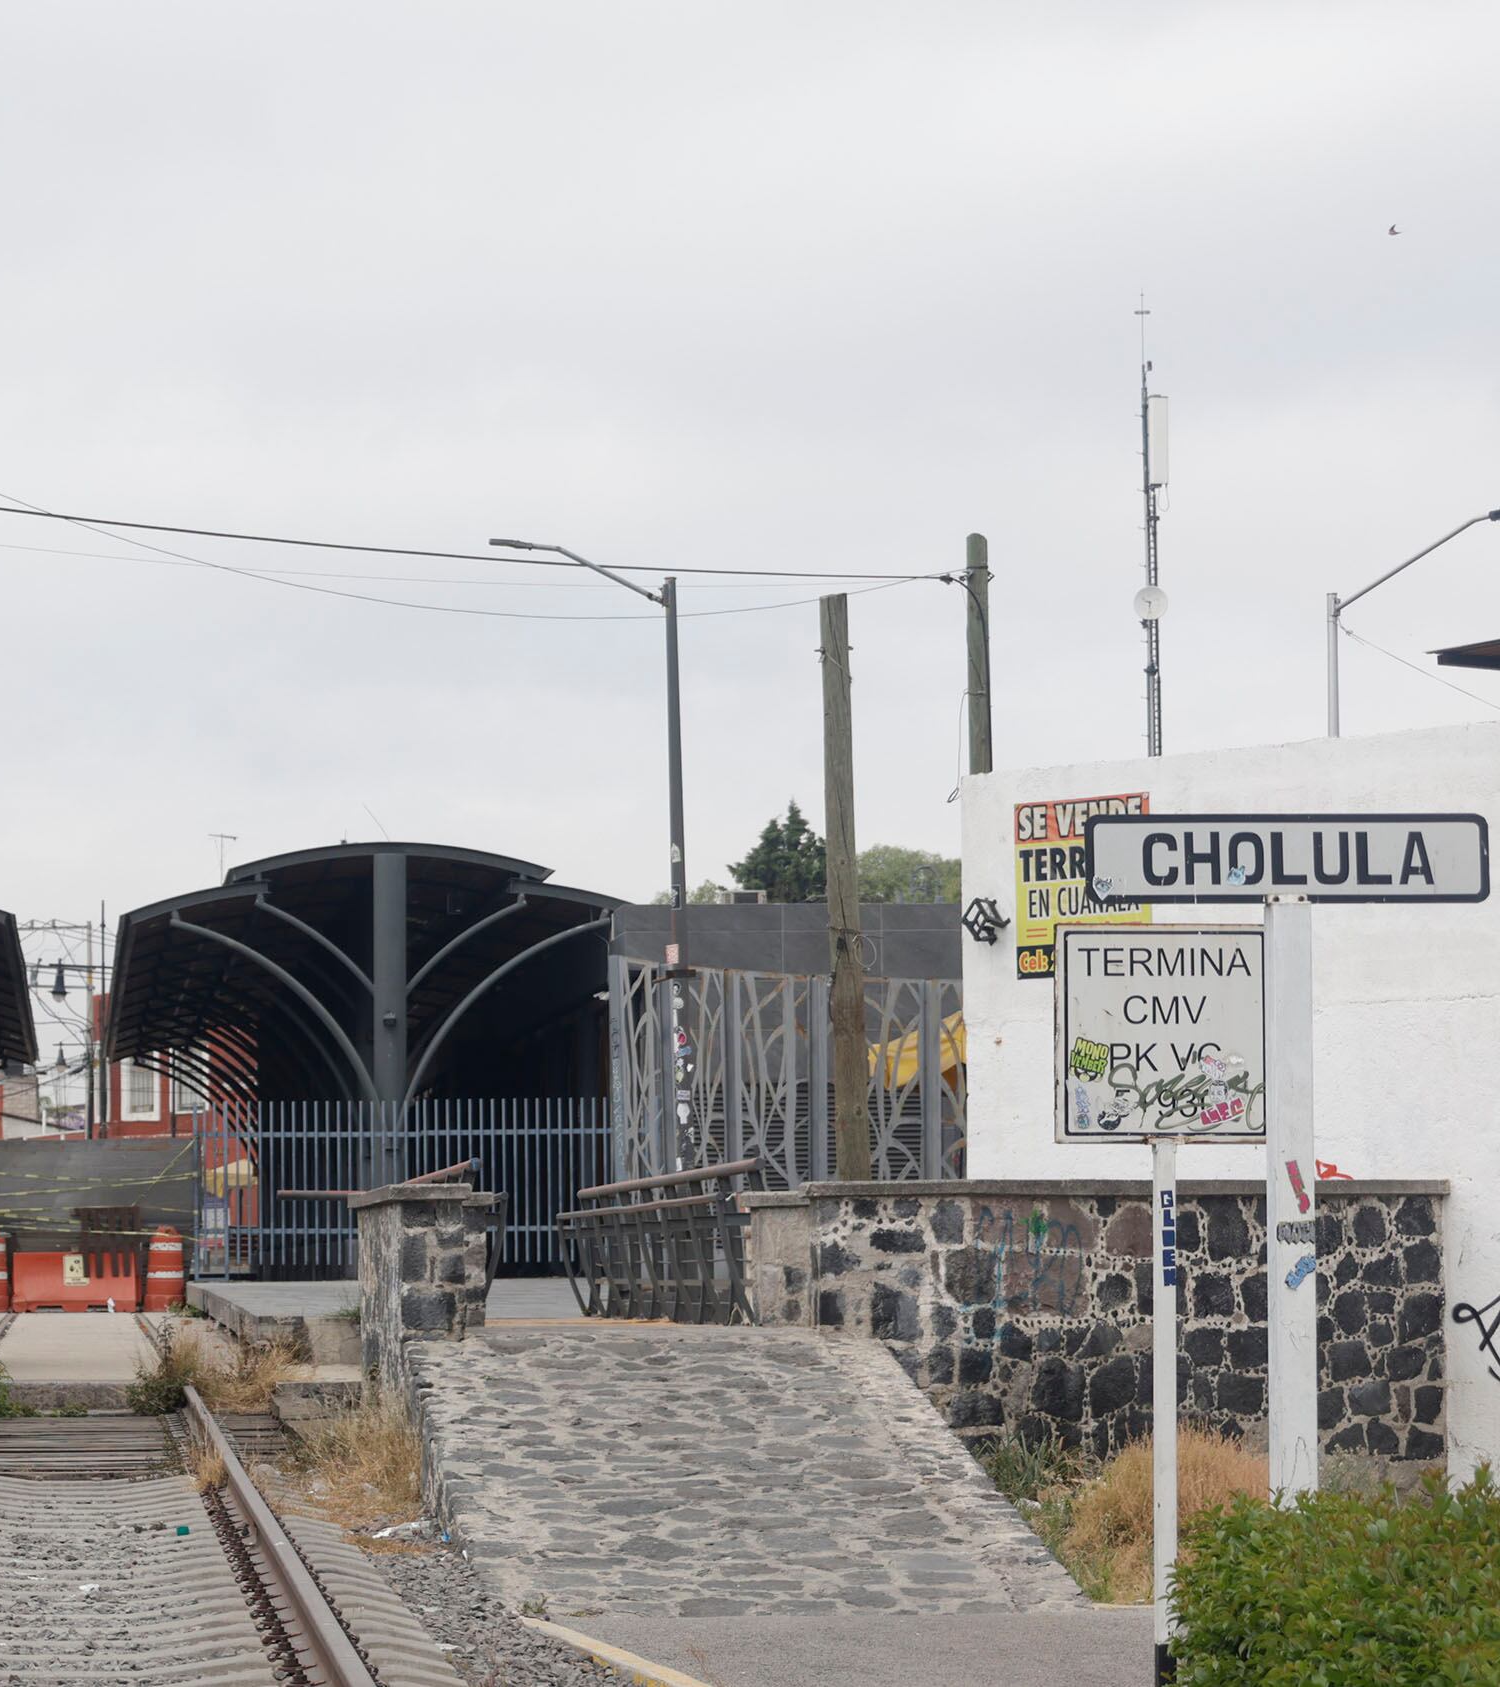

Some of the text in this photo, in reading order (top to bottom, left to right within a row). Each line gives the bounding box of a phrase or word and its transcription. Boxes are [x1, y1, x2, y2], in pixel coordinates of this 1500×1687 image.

[1018, 805, 1047, 841] SE
[1019, 846, 1085, 882] TERR
[1142, 831, 1435, 886] CHOLULA
[1028, 889, 1050, 918] EN
[1078, 947, 1252, 977] TERMINA
[1123, 995, 1207, 1025] CMV
[1070, 1051, 1109, 1074] VEMBER
[1074, 1037, 1110, 1060] MONO
[1110, 1043, 1158, 1072] PK
